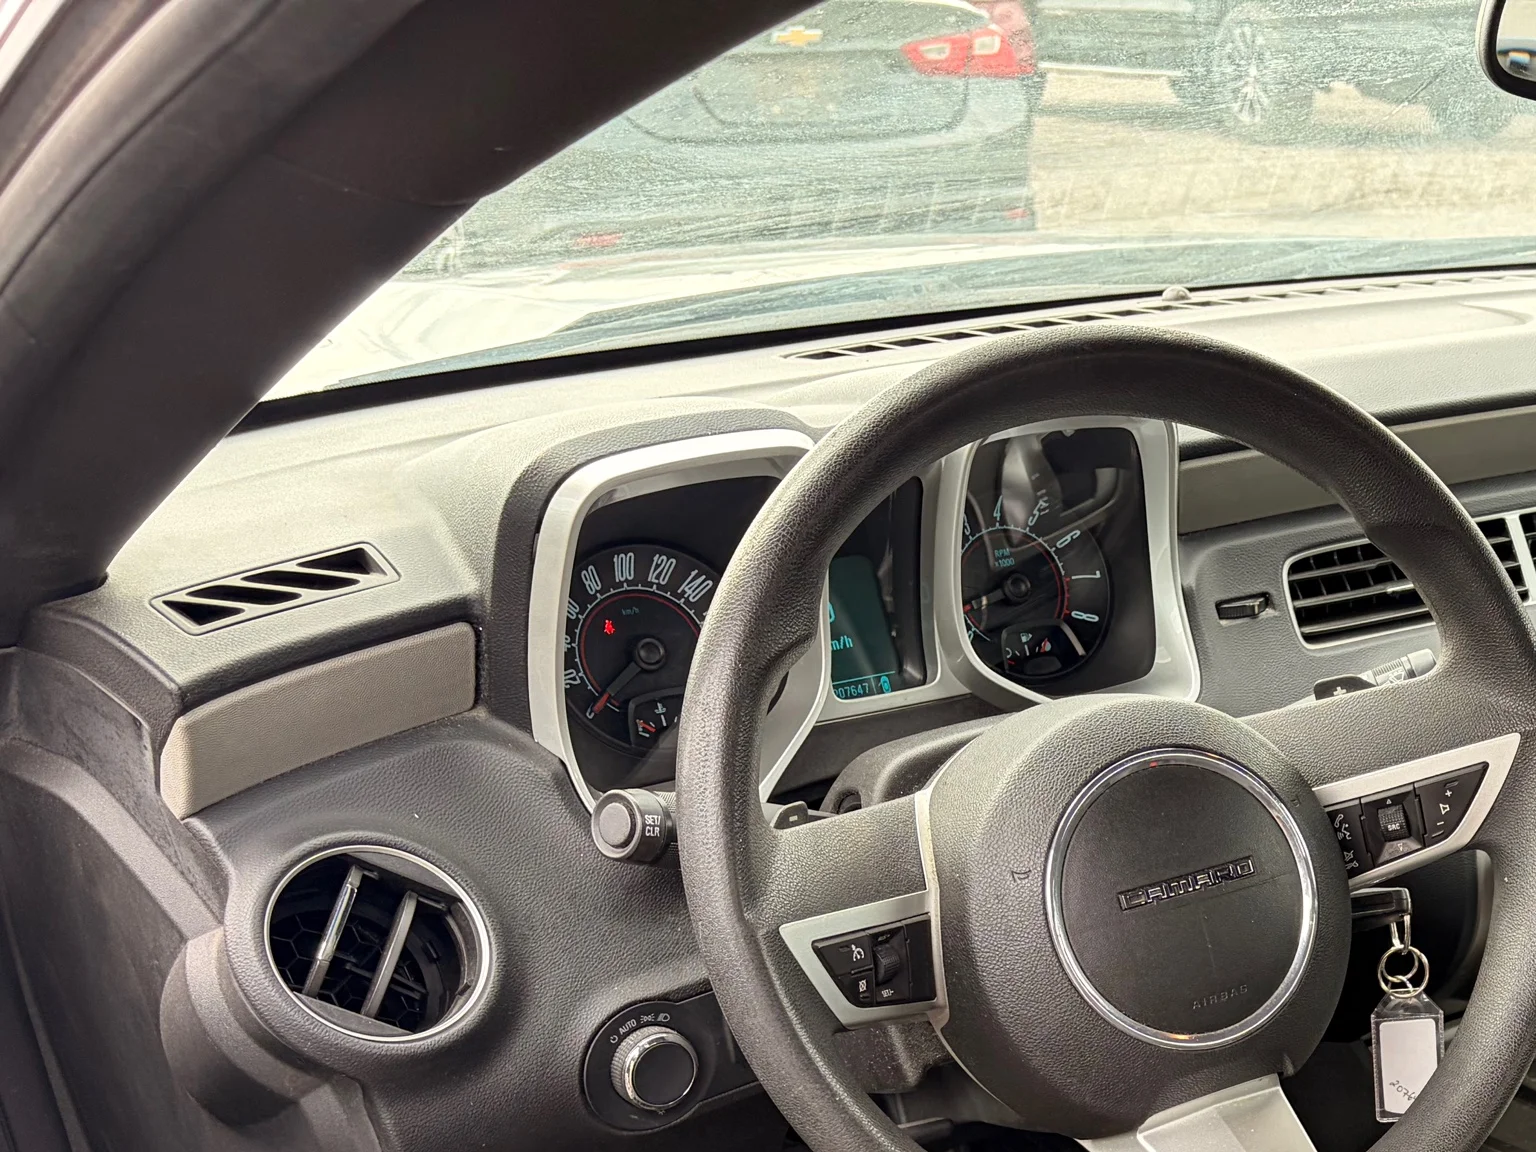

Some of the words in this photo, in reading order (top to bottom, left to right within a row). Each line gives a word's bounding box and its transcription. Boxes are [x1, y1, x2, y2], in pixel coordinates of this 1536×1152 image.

[993, 495, 1004, 520] 4
[1056, 529, 1081, 548] 6
[994, 548, 1011, 558] RPM
[613, 552, 635, 583] 100
[647, 553, 677, 586] 120
[1071, 570, 1101, 580] 7
[581, 565, 602, 595] 80
[677, 569, 714, 603] 140
[621, 607, 640, 616] km/h
[1071, 611, 1099, 623] 8
[644, 814, 661, 825] SET/
[1387, 822, 1401, 832] SRC
[645, 826, 660, 837] CLR
[1118, 856, 1255, 911] CAMARO
[1192, 984, 1249, 1010] AIRBAG
[618, 1018, 637, 1036] AUTO
